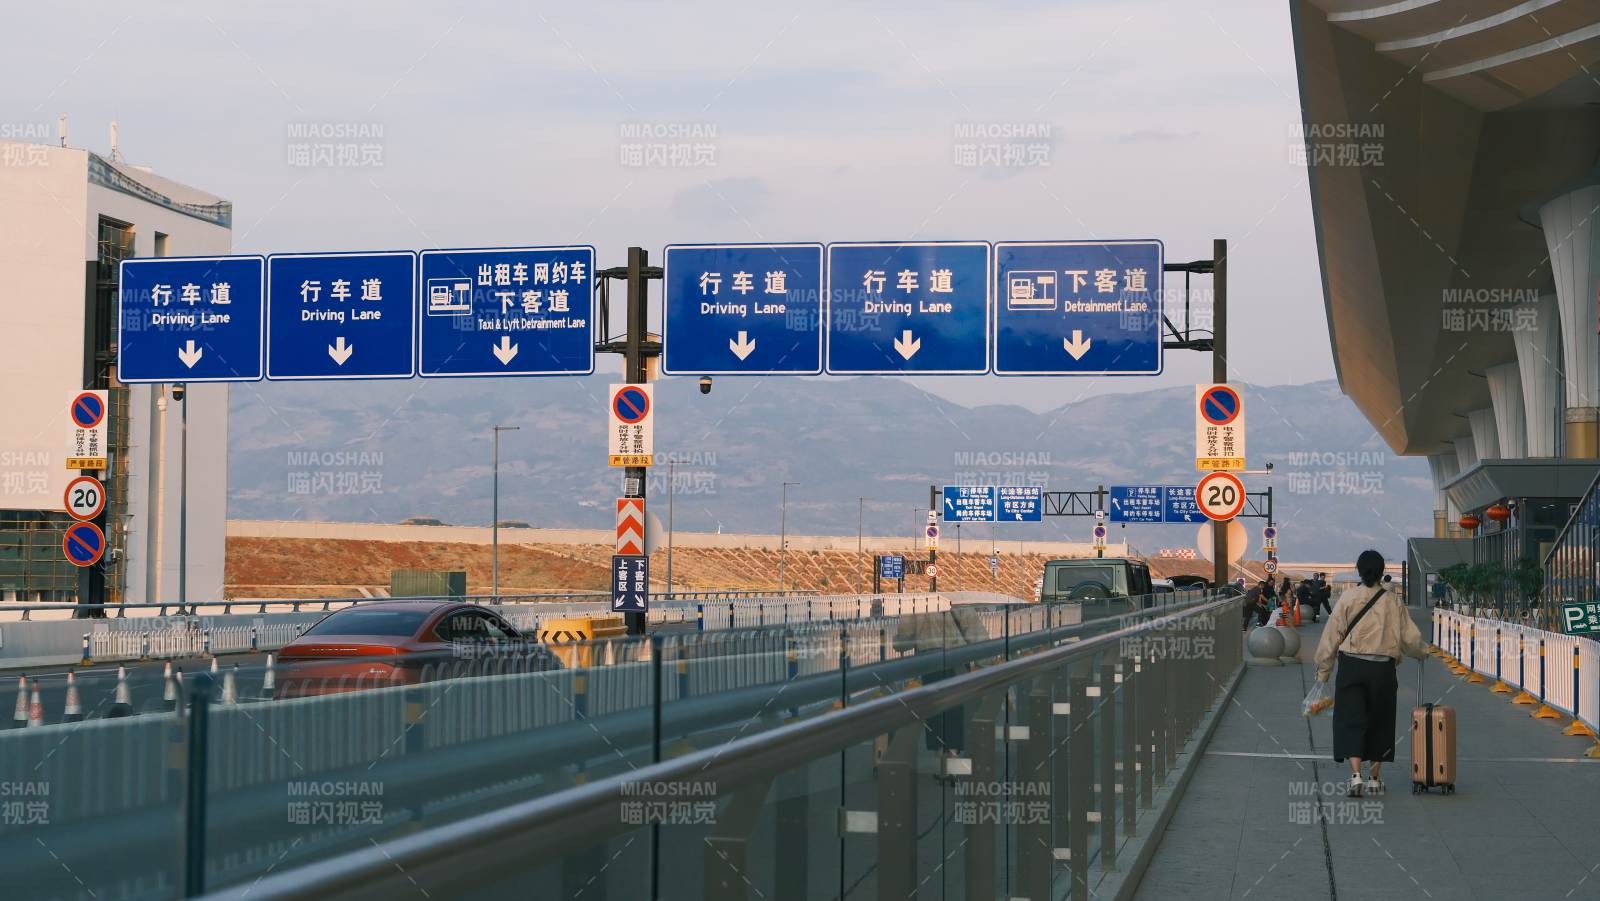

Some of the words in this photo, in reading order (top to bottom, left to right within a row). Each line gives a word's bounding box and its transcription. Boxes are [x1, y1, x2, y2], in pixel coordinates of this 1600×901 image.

[479, 263, 528, 286] 出租车
[535, 262, 586, 285] 网约车
[700, 271, 787, 295] 行车道
[864, 269, 953, 294] 行车道
[1065, 268, 1148, 293] 下客道
[152, 283, 231, 306] 行车道
[301, 279, 382, 303] 行车道
[495, 290, 570, 314] 下客道
[701, 303, 747, 318] Driving
[754, 302, 786, 314] Lane
[865, 301, 912, 316] Driving
[920, 301, 953, 313] Lane
[1064, 300, 1121, 313] Detrainment
[1124, 299, 1148, 312] Lane
[153, 313, 194, 327] Driving
[202, 312, 230, 324] Lane
[302, 310, 345, 324] Driving
[352, 309, 381, 320] Lane
[478, 319, 494, 330] Taxi
[496, 319, 502, 330] &
[503, 319, 520, 332] Lyft
[521, 318, 566, 329] Detrainment
[567, 317, 586, 328] Lane
[74, 489, 97, 508] 20
[1168, 488, 1196, 496] 长途客
[1208, 485, 1235, 506] 20
[1004, 501, 1035, 509] 市区方向
[618, 559, 628, 592] 上客区
[634, 559, 645, 592] 下客区
[1564, 607, 1584, 631] P
[1586, 604, 1600, 614] 网
